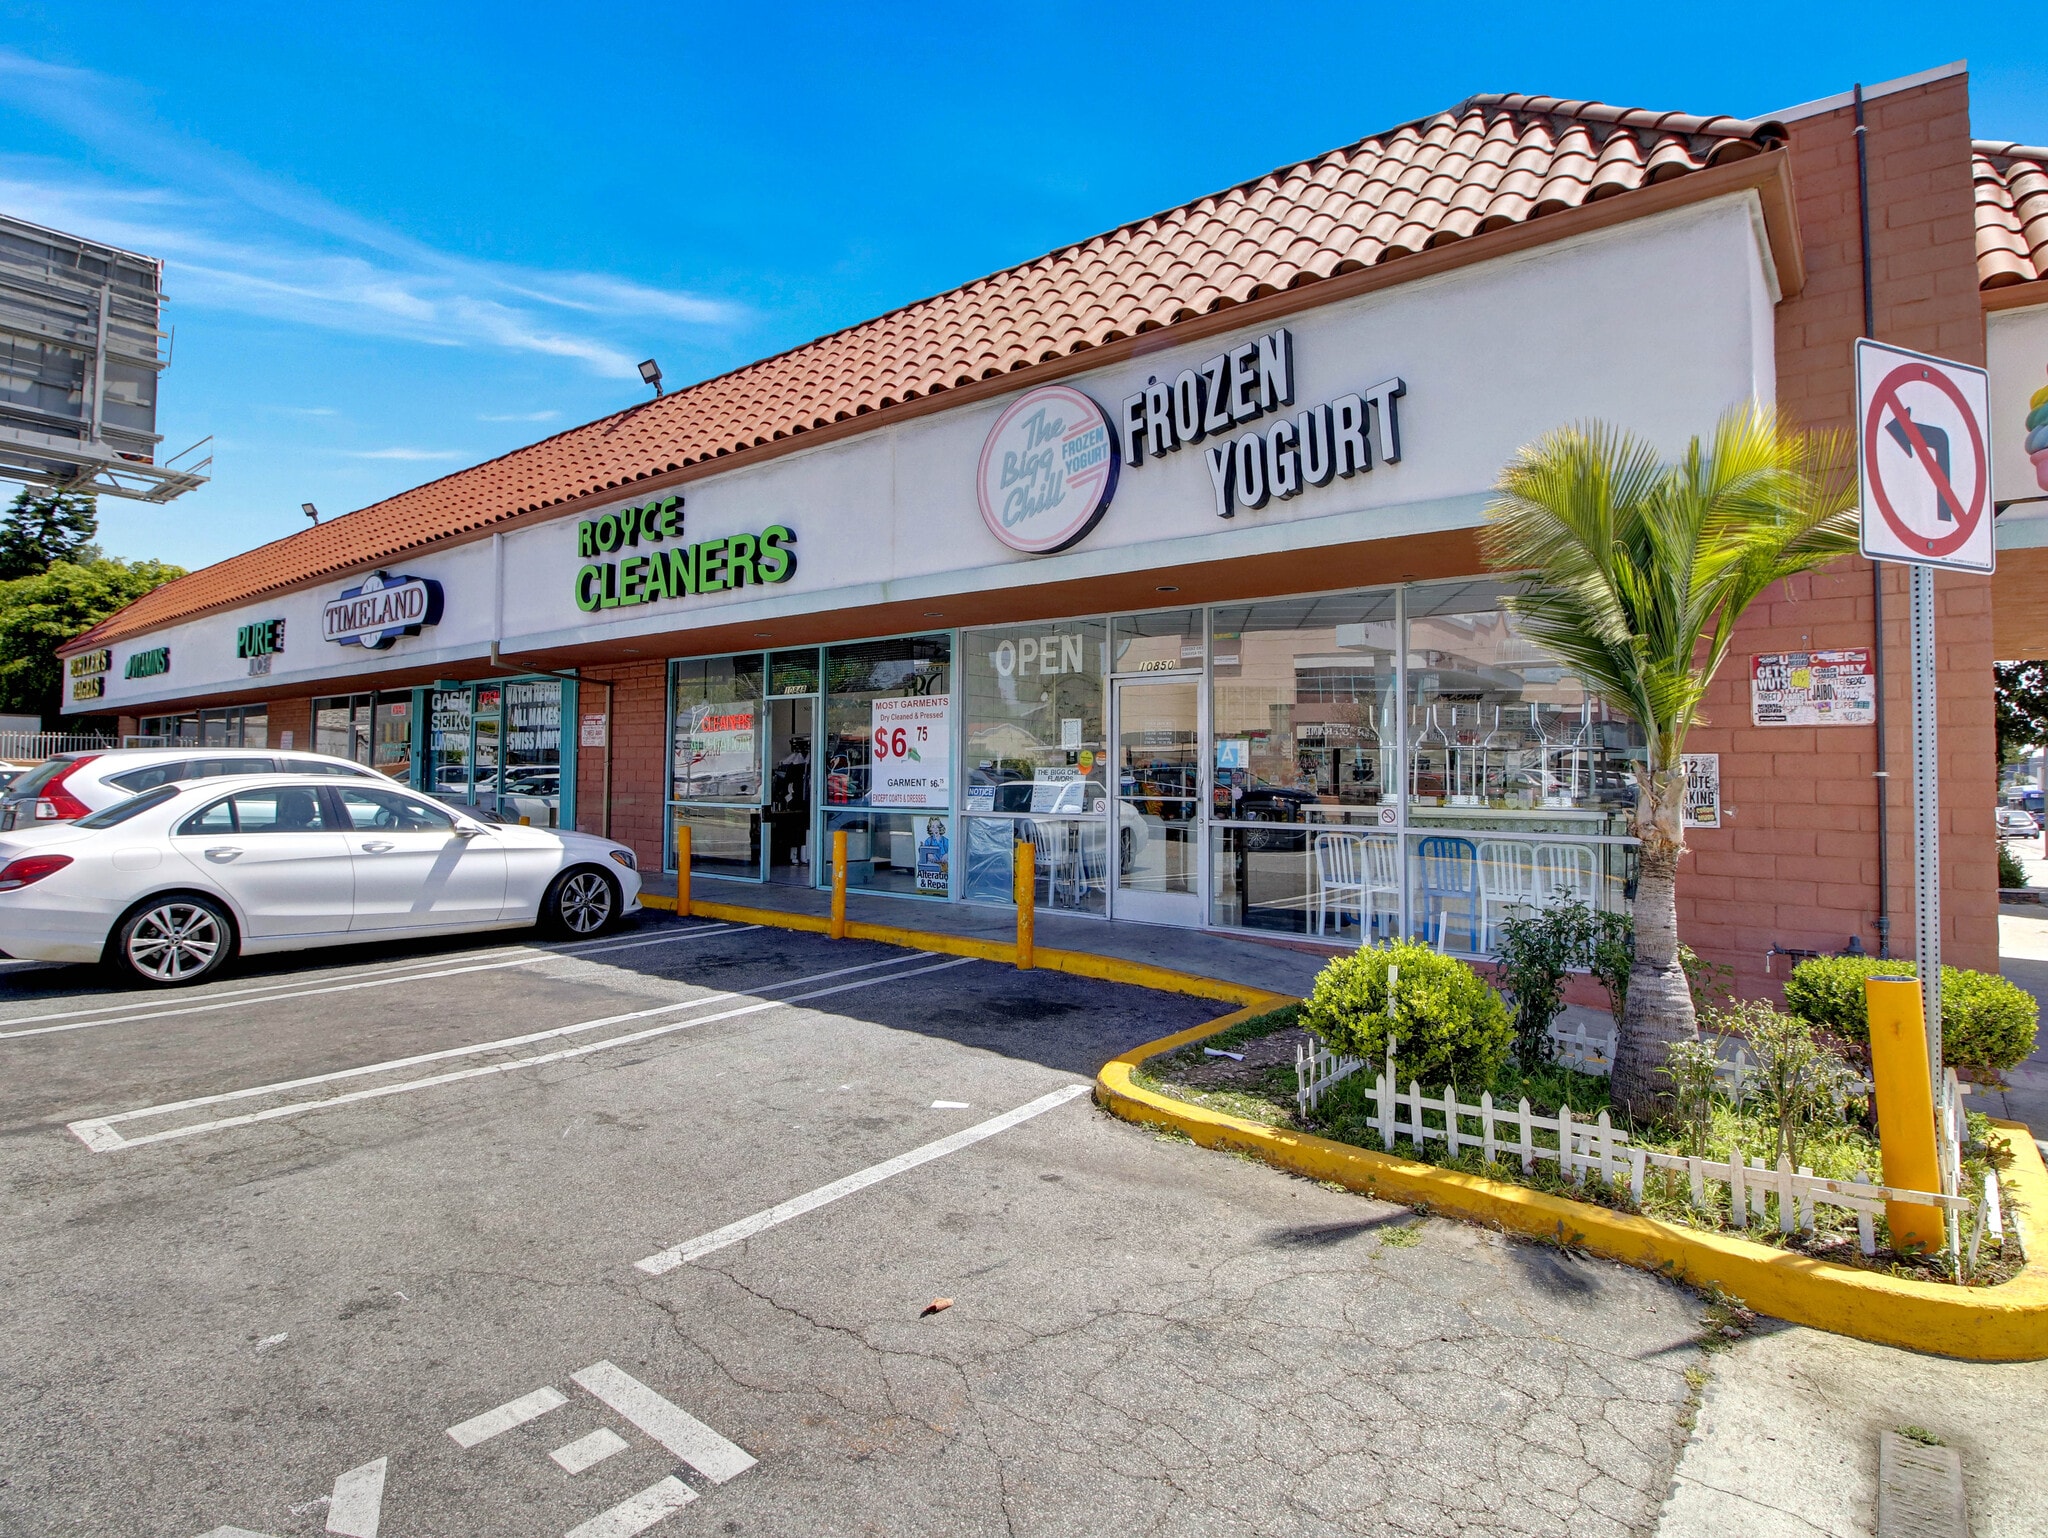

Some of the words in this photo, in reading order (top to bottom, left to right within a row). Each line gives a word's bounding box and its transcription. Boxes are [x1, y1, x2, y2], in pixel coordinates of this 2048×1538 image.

[1122, 328, 1294, 467] FROZEN
[1021, 407, 1066, 451] The
[1061, 426, 1105, 460] FROZEN
[1064, 443, 1109, 476] YOGURT
[1204, 376, 1407, 519] YOGURT
[1000, 447, 1054, 490] Bigg
[1002, 469, 1066, 528] Chill
[578, 495, 685, 558] ROYCE
[575, 525, 798, 612] CLEANERS
[326, 587, 424, 635] TIMELAND
[237, 619, 282, 659] PURE
[995, 633, 1083, 677] OPEN
[1140, 660, 1175, 672] 10850
[513, 707, 528, 727] ALL
[529, 705, 560, 726] MAKES
[875, 701, 898, 710] MOST
[900, 697, 949, 708] GARMENTS
[880, 714, 889, 722] Dry
[891, 712, 913, 720] Cleaned
[920, 711, 944, 719] Pressed
[431, 711, 470, 731] SEIKO
[702, 713, 753, 732] CLEANERS
[509, 731, 534, 751] SWISS
[874, 726, 907, 762] $6
[917, 726, 928, 741] 75
[1220, 746, 1234, 762] A
[872, 793, 888, 803] EXCEPT
[889, 794, 902, 803] COATS
[907, 794, 927, 803] DRESSES
[887, 778, 926, 787] GARMENT
[968, 787, 994, 797] NOTICE
[920, 880, 926, 888] &
